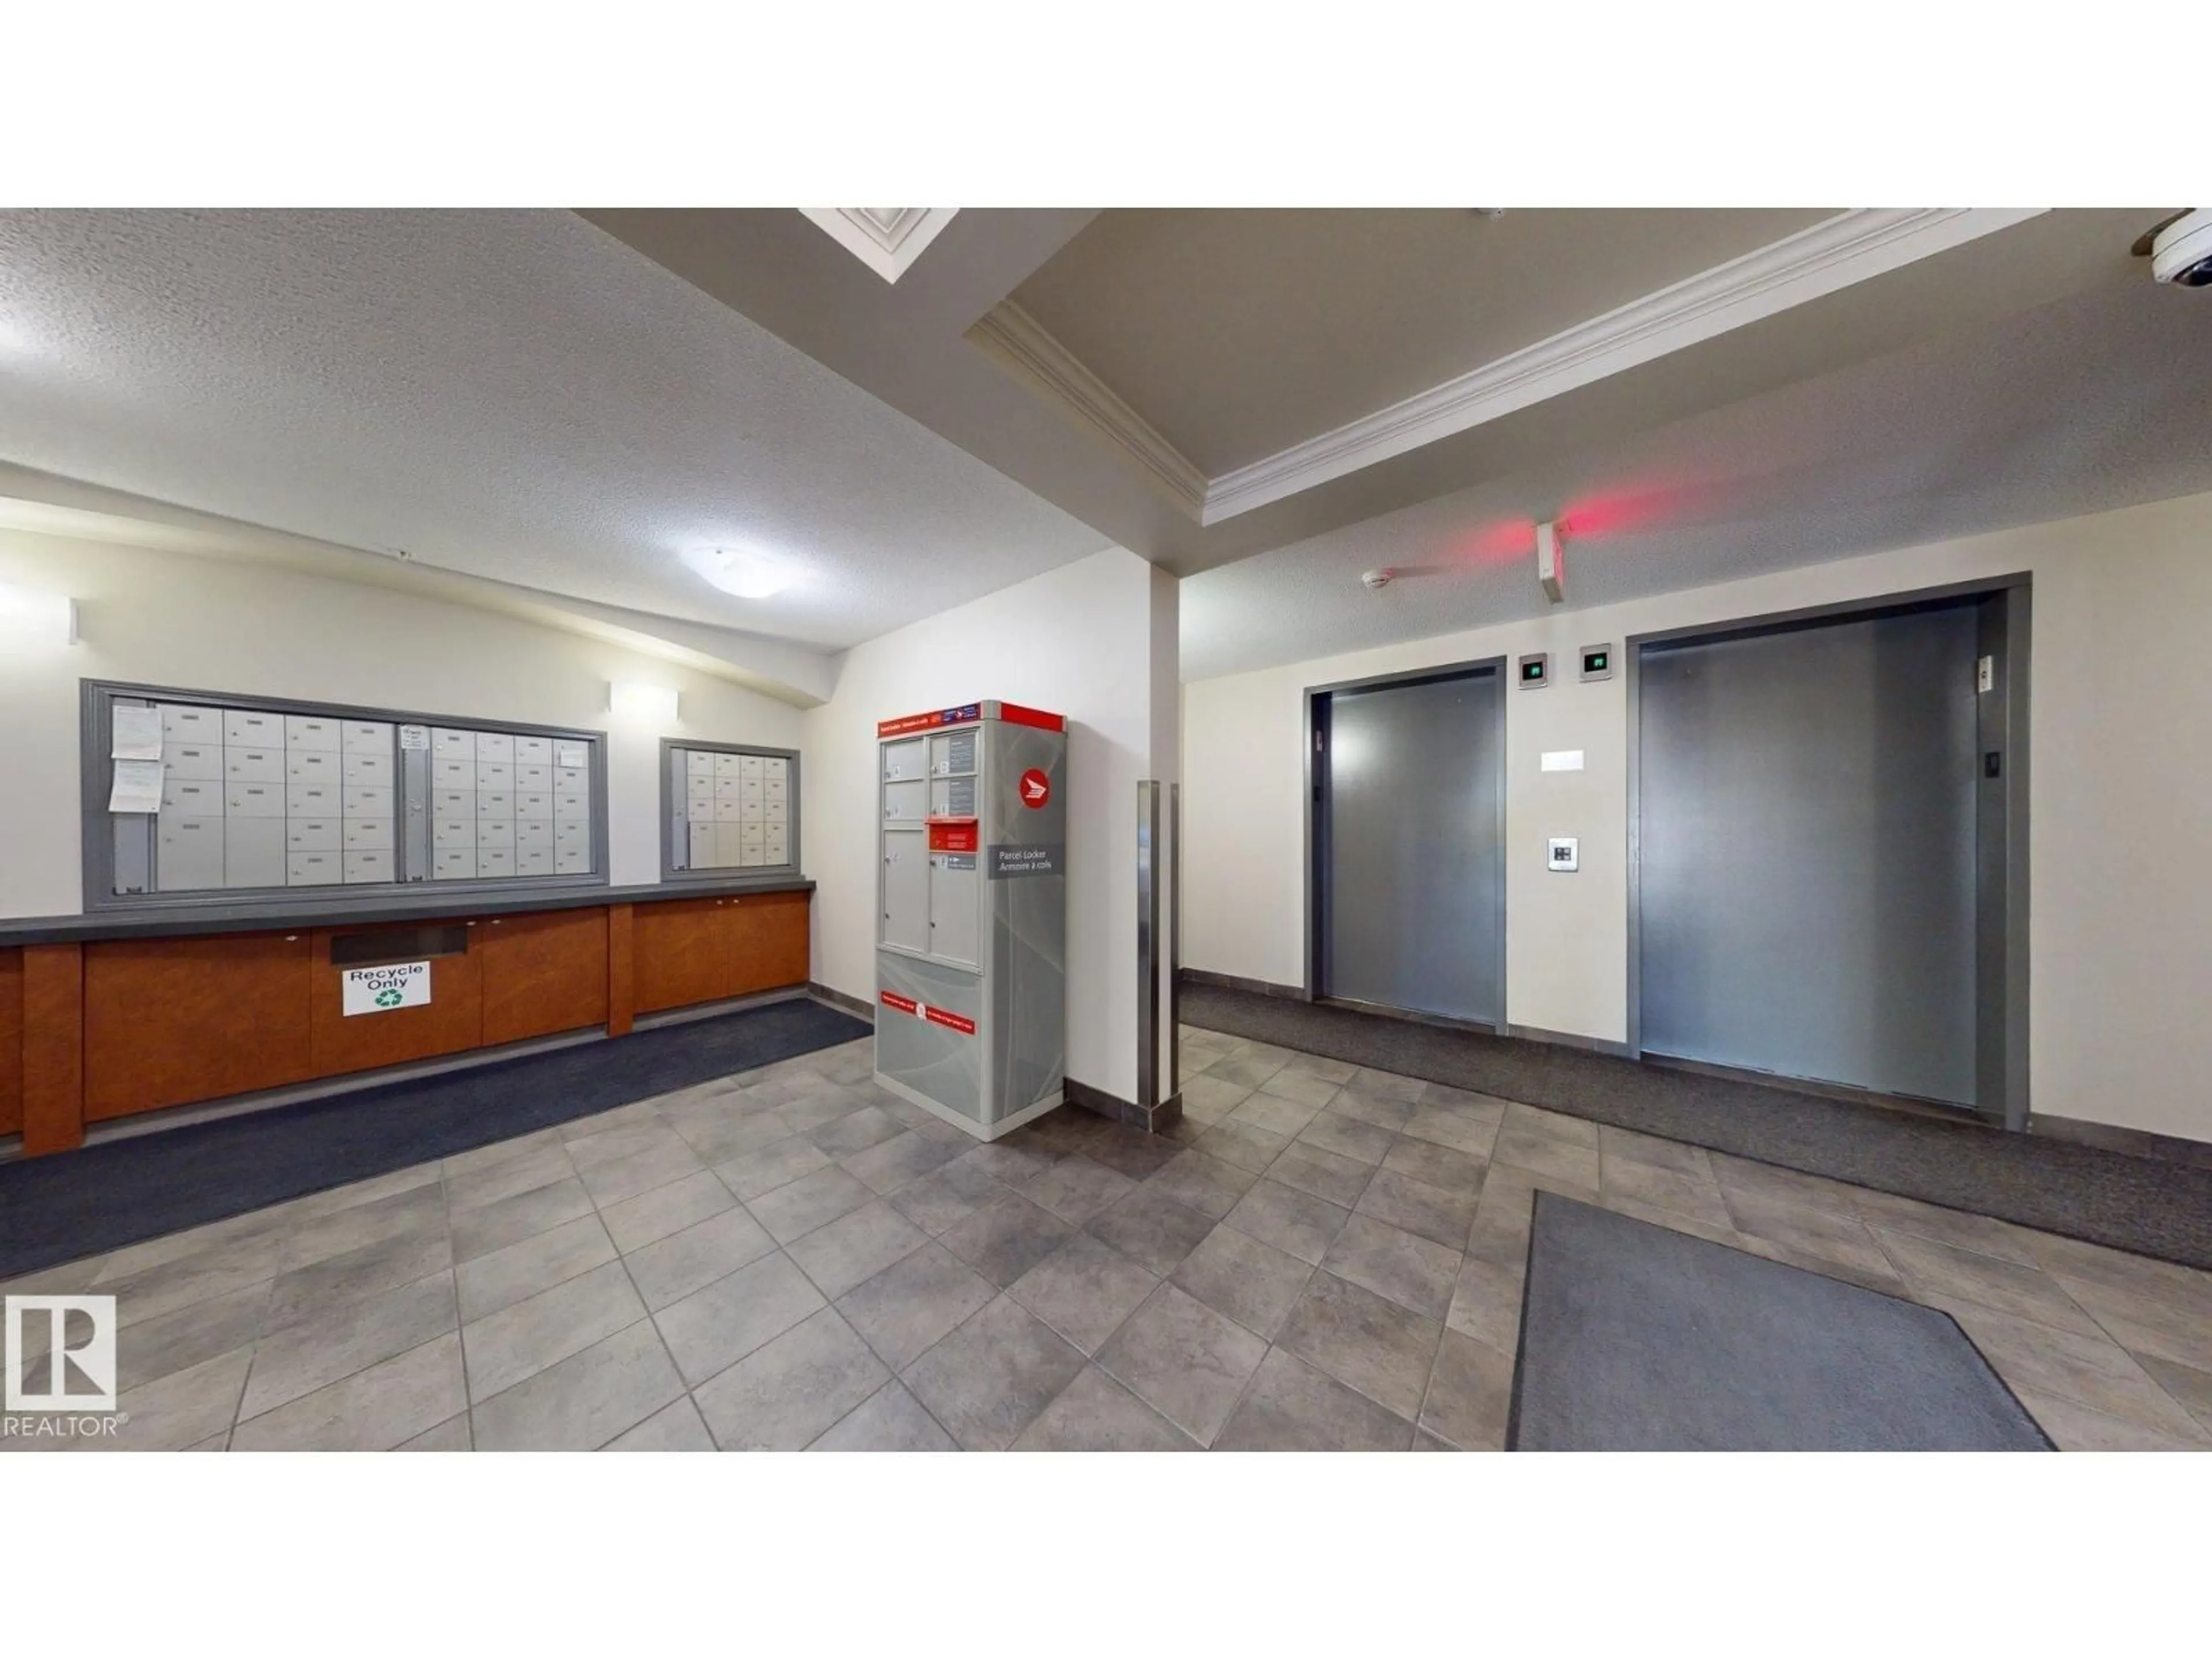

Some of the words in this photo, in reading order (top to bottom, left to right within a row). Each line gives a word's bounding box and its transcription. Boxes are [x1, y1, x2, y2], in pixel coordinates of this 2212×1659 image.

[999, 851, 1022, 859] Parcel
[1023, 850, 1046, 859] Locker
[350, 965, 423, 981] Recycle
[368, 978, 408, 990] Only
